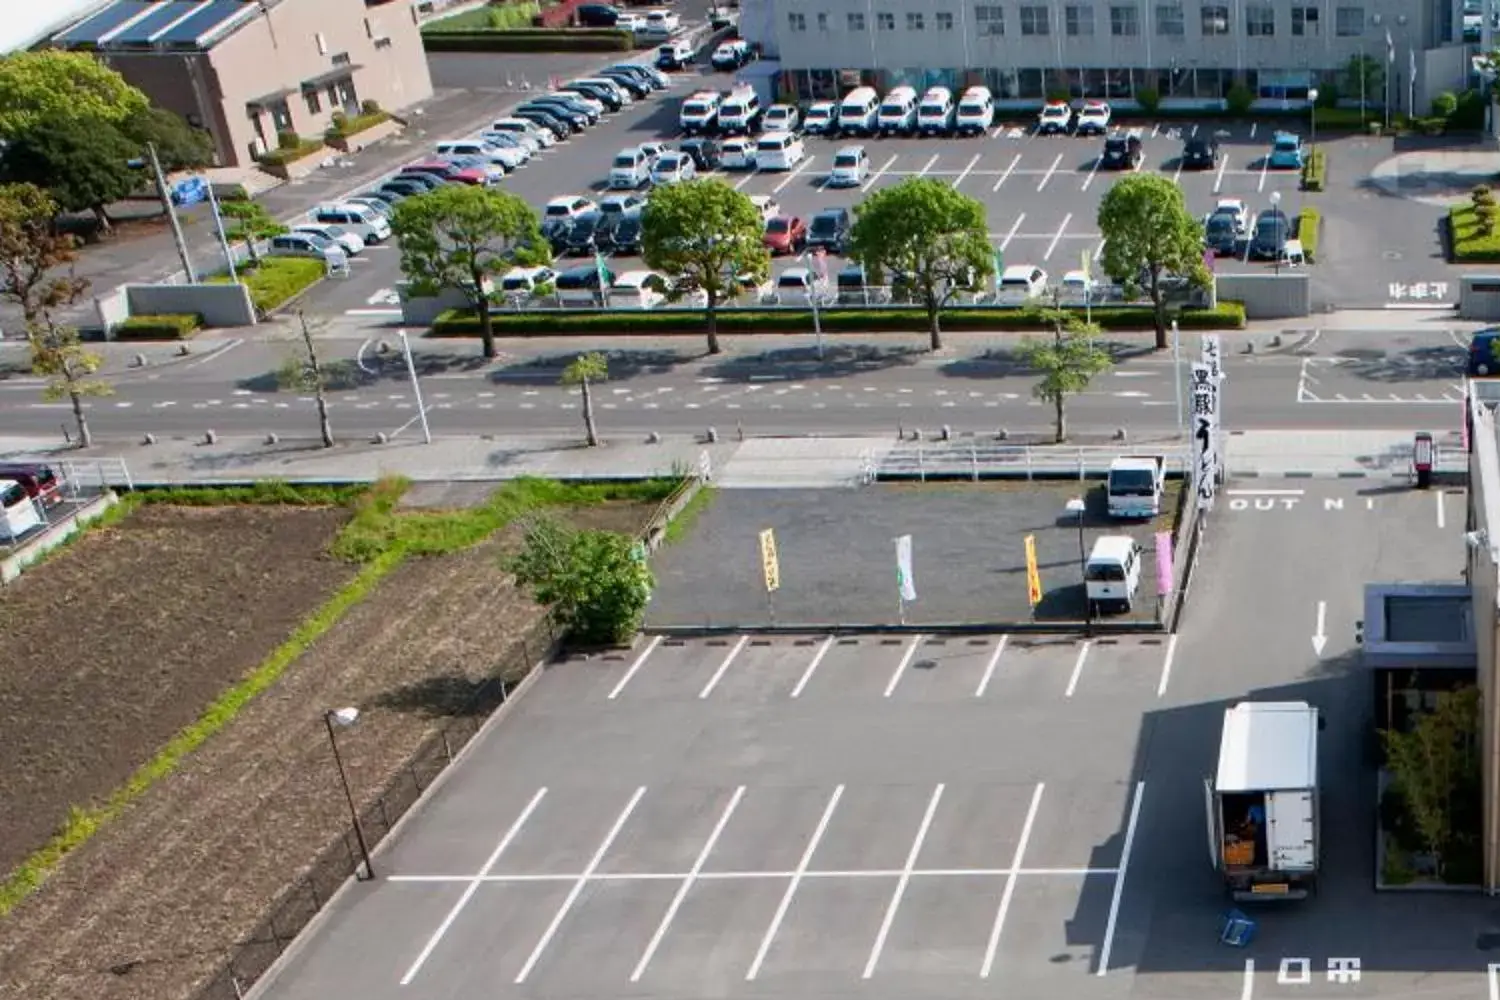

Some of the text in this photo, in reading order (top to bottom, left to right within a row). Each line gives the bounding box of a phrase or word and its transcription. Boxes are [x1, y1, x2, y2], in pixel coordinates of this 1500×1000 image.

[1388, 281, 1448, 299] 止まれ
[1193, 367, 1214, 500] 黒豚うどん
[1229, 497, 1300, 511] OUT
[1277, 957, 1361, 984] 出口
